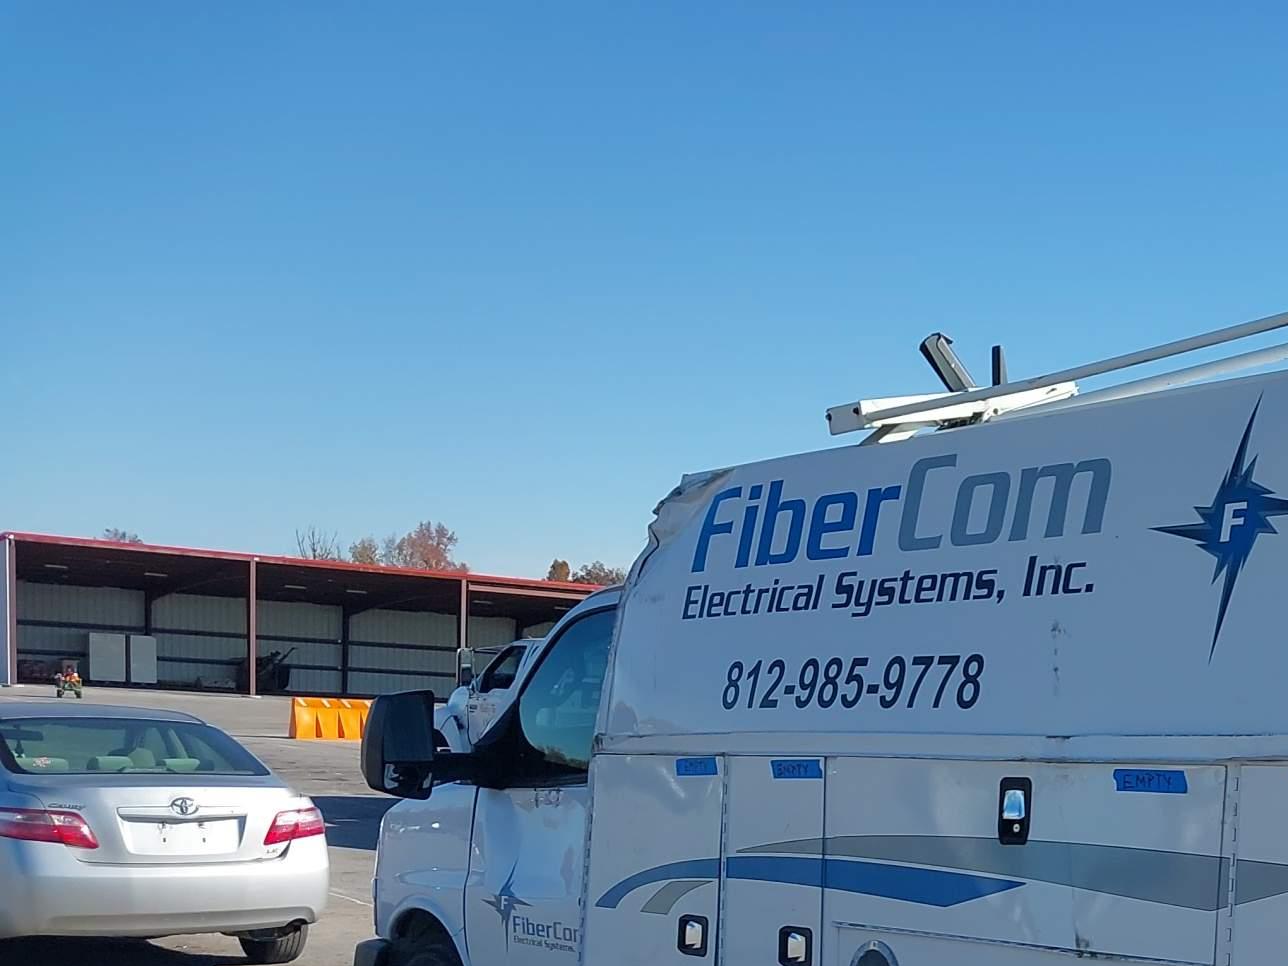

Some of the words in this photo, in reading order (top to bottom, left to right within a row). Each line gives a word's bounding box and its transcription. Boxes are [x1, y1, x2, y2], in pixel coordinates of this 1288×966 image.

[691, 454, 1112, 574] FiberCom
[1219, 502, 1249, 542] F
[681, 575, 823, 620] Electrical
[832, 569, 1005, 618] Systems,
[1022, 556, 1096, 597] Inc.
[721, 653, 985, 710] 812-985-9778
[1123, 773, 1172, 790] EMPTY
